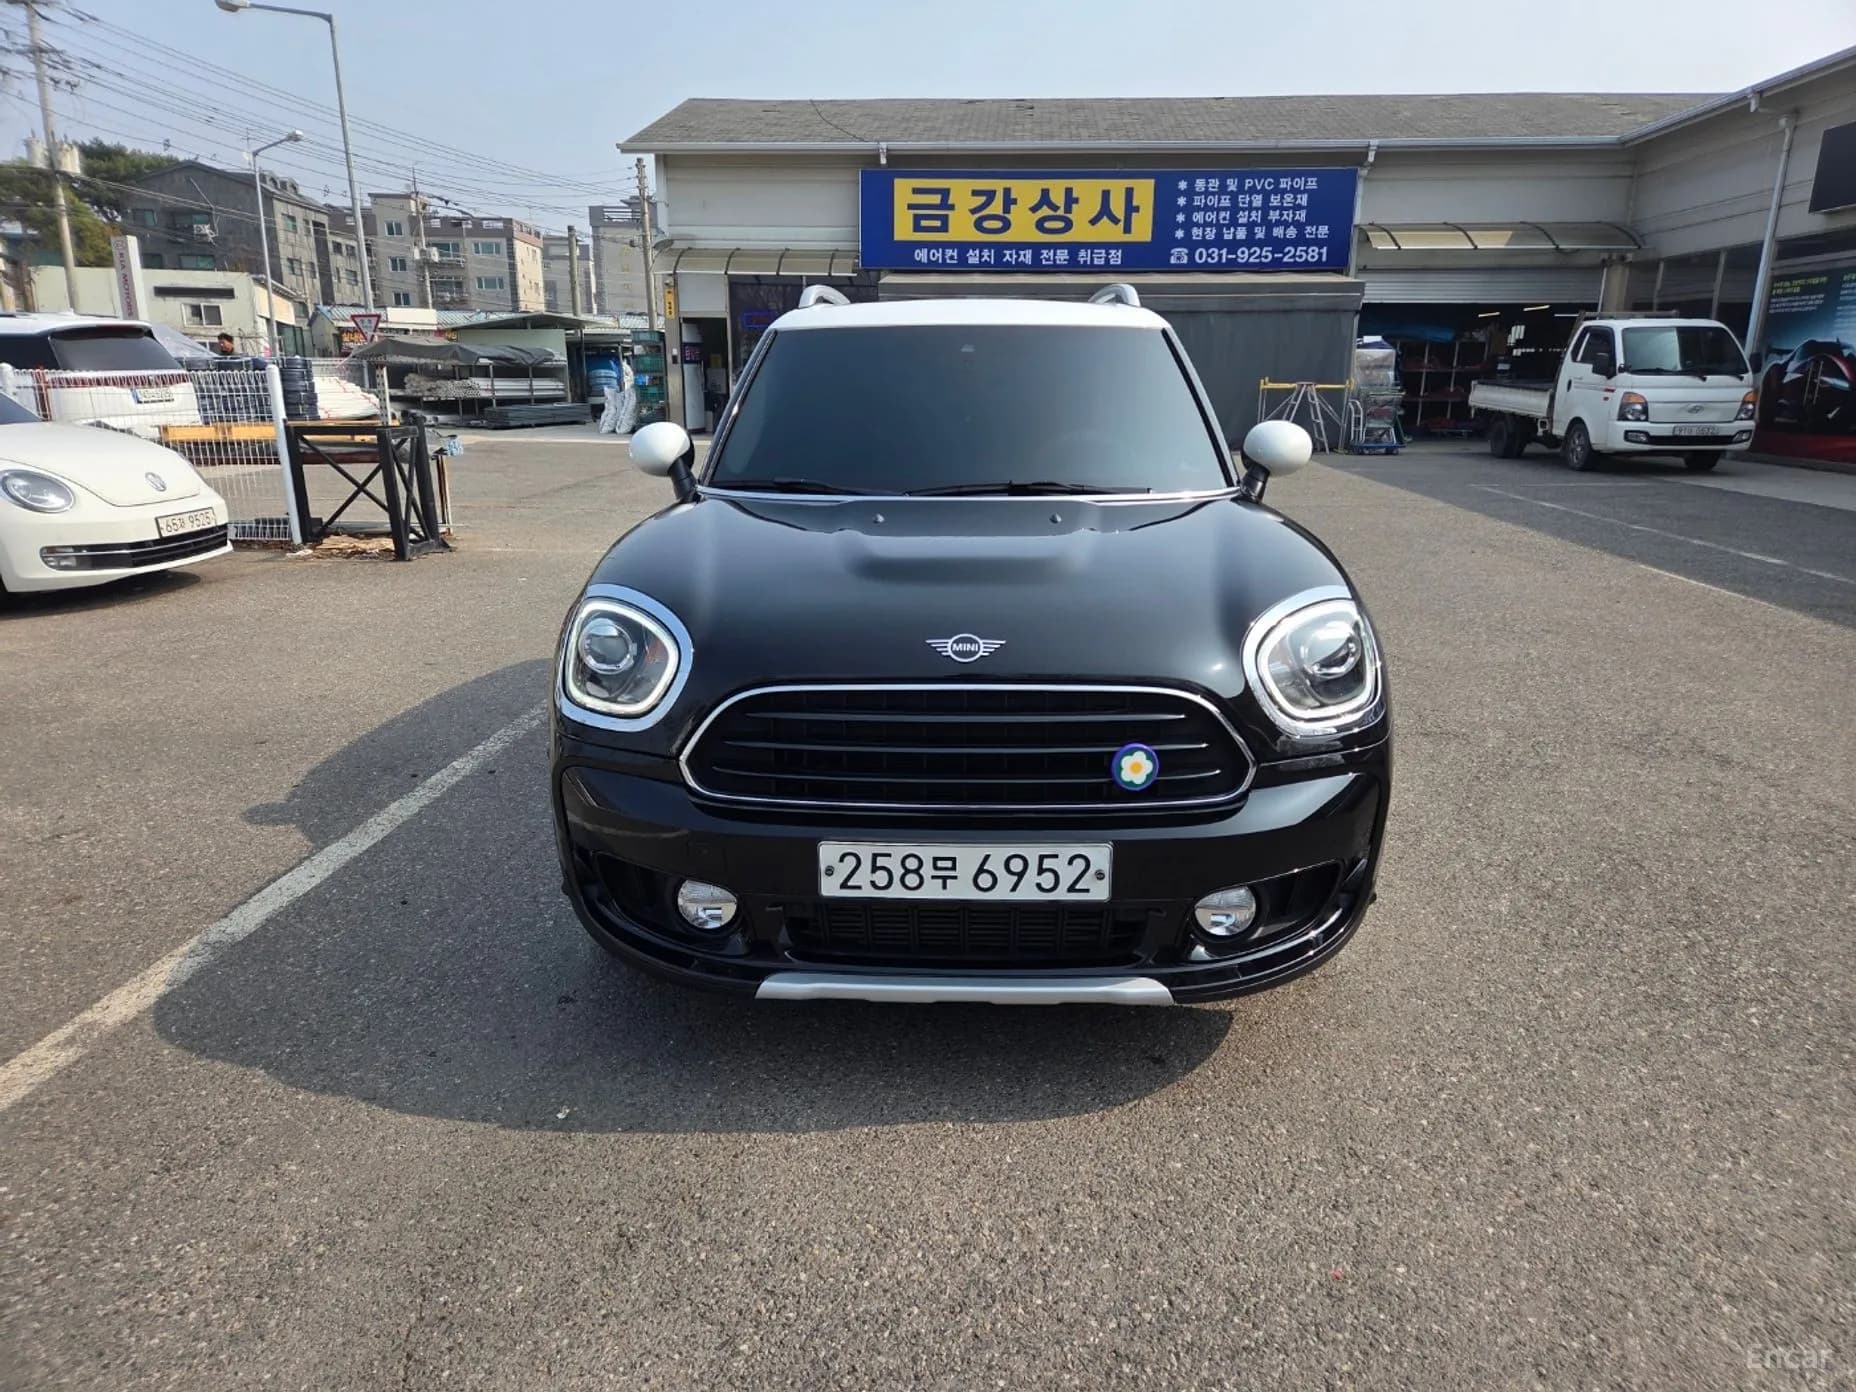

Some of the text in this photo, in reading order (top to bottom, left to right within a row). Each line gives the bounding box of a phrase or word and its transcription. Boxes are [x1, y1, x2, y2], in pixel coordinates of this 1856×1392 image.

[1194, 177, 1318, 192] 동관 및 PVC 파이프
[1192, 193, 1308, 208] 파이프 단열 보온재
[906, 186, 1140, 235] 금강상사
[1192, 209, 1307, 224] 에어컨 설치 부자재
[1191, 225, 1330, 240] 현장 납품 및 배송 전문
[914, 248, 1122, 265] 에어컨 설치 자재 전문 취급점
[1194, 246, 1328, 263] 031-925-2581
[188, 511, 211, 528] 9525
[952, 643, 979, 652] MINI
[838, 852, 1091, 893] 258무 6952
